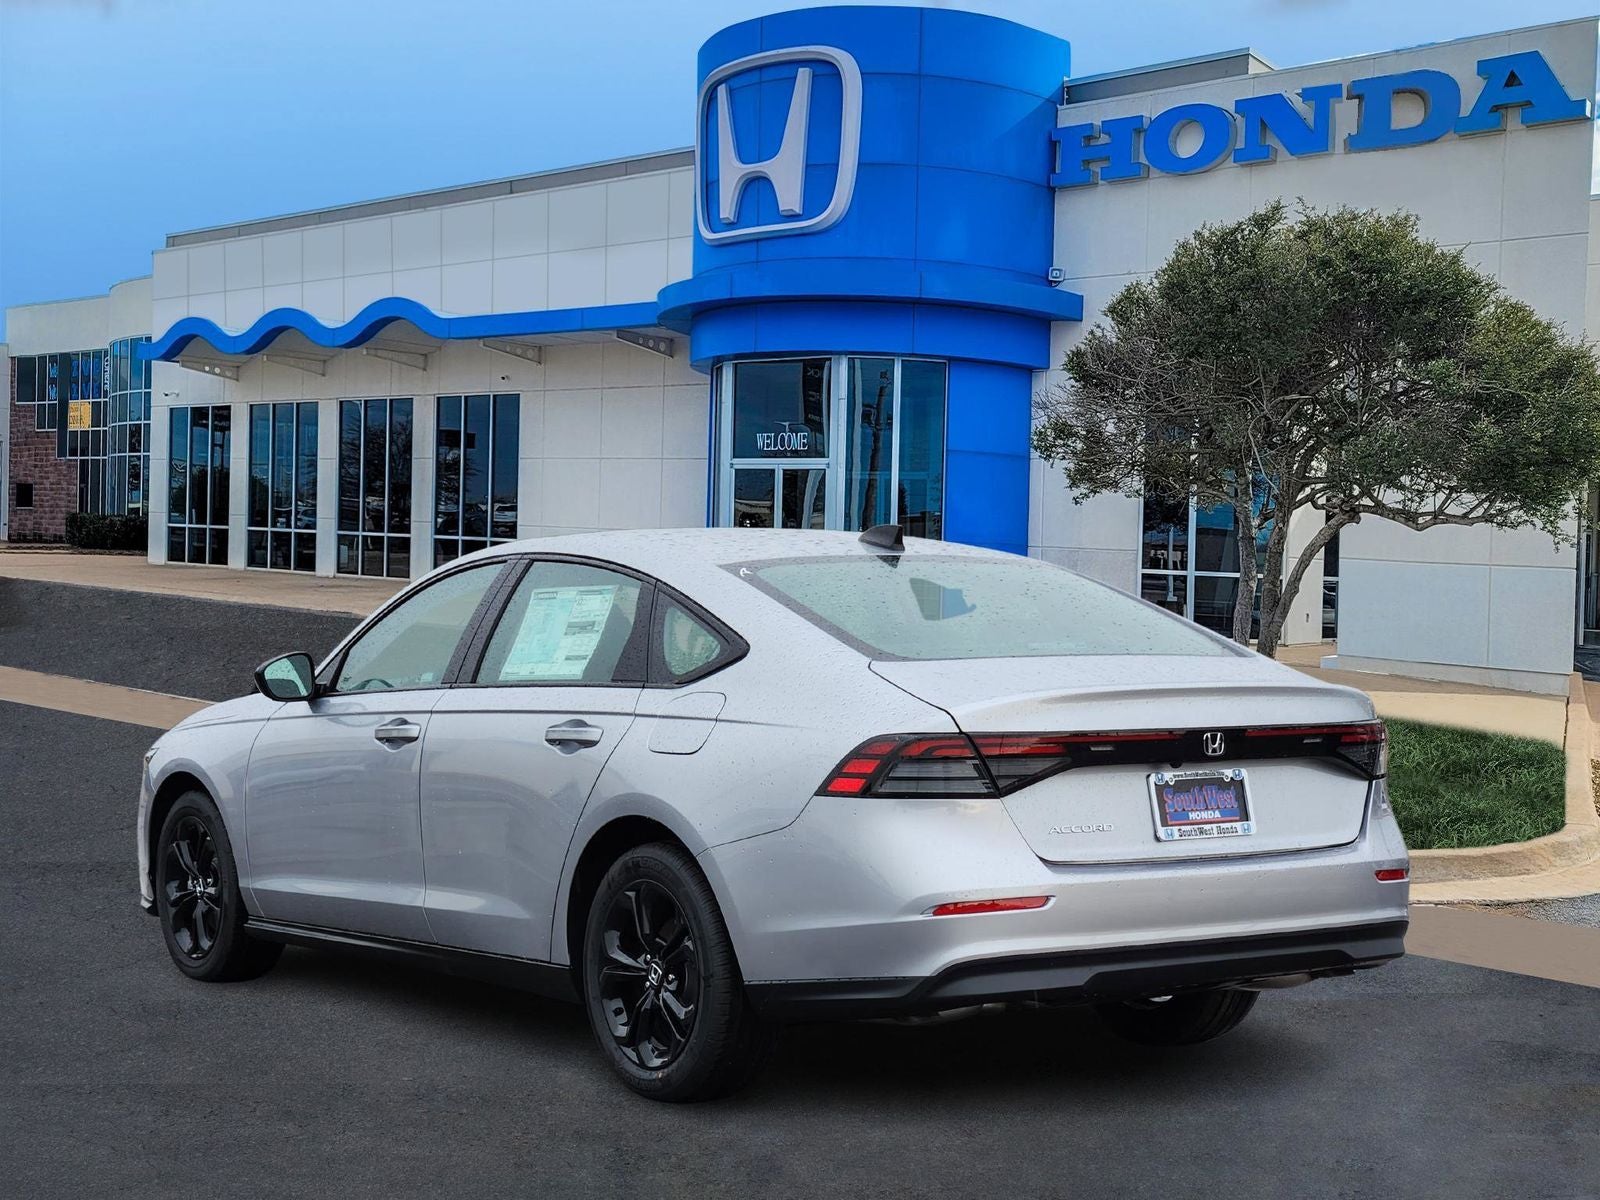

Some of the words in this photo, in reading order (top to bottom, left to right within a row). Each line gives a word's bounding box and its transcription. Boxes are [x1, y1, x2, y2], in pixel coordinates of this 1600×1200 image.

[1051, 50, 1592, 188] HONDA
[756, 432, 808, 451] WELCOME
[1188, 810, 1222, 820] HONDA
[1049, 823, 1114, 834] ACCORD
[1178, 827, 1214, 838] SouthWest
[1216, 825, 1239, 835] Honda
